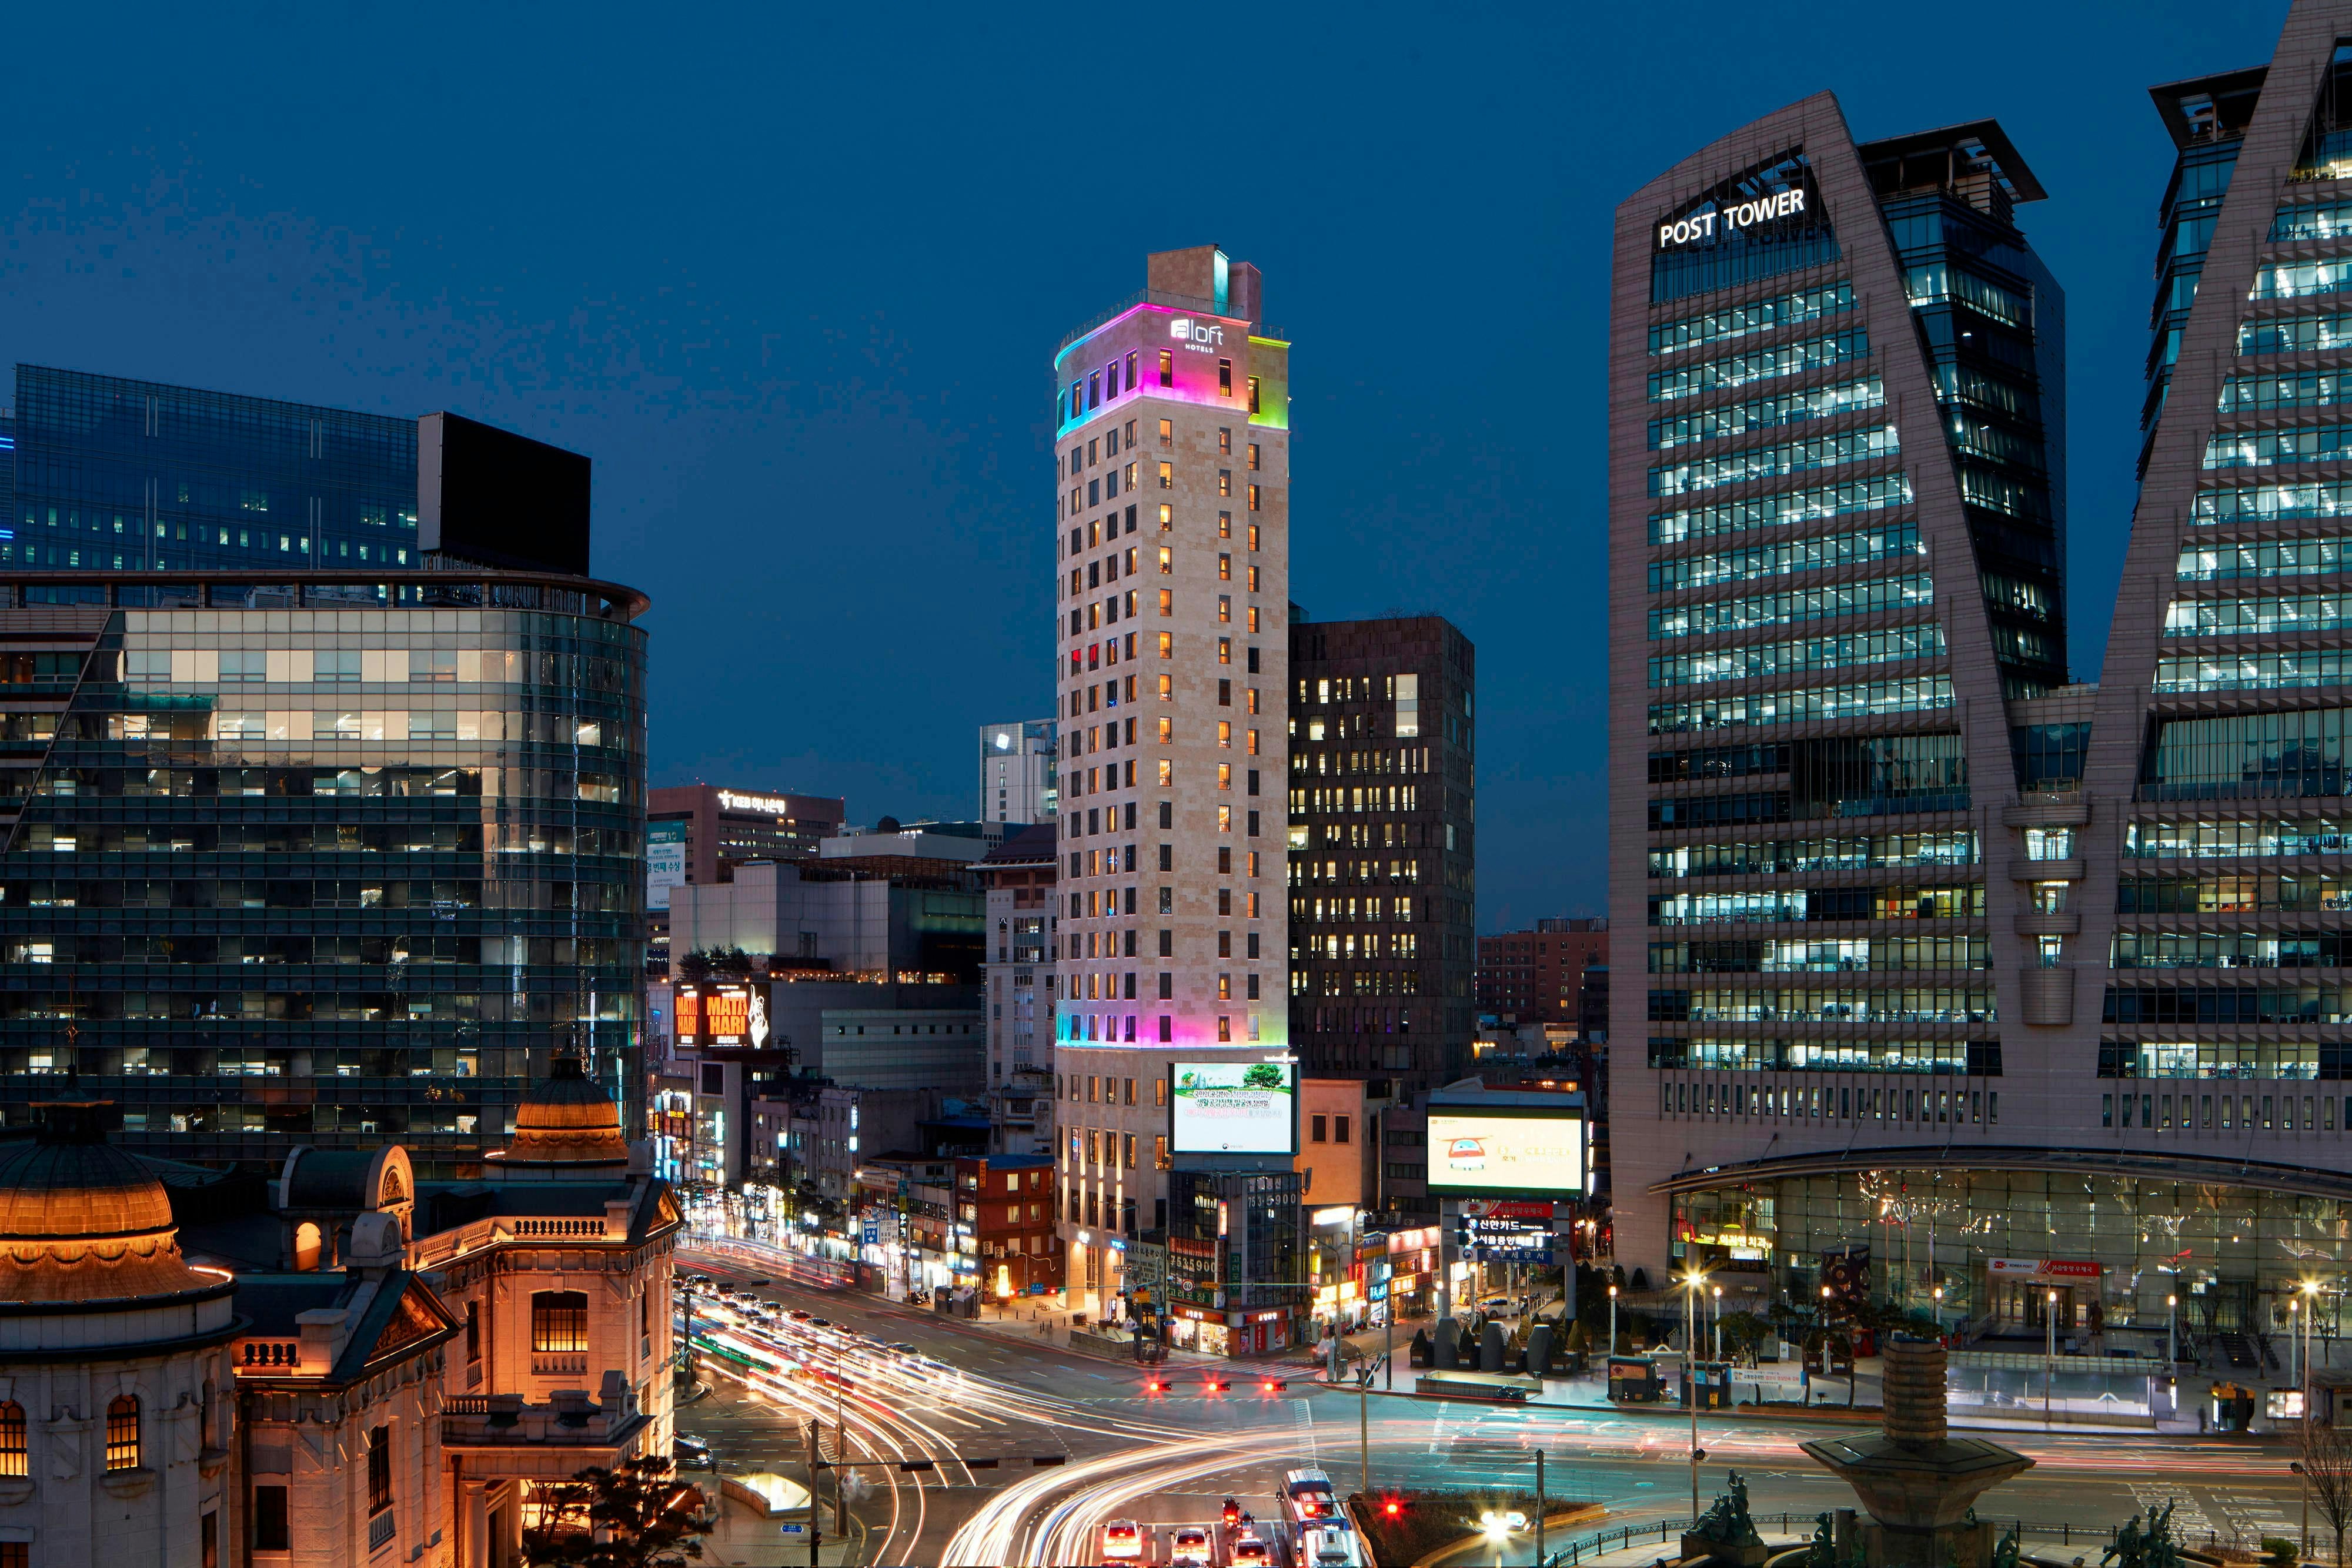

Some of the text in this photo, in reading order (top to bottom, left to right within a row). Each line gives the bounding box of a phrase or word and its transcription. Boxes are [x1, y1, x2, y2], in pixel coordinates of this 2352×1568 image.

[1661, 189, 1805, 248] POST TOWER
[1171, 319, 1223, 345] aloft
[1185, 343, 1214, 353] HOTELS
[733, 795, 786, 814] KEB 하나은행
[653, 862, 666, 872] 번째
[668, 861, 680, 872] 수상
[676, 997, 697, 1015] MATA
[707, 997, 748, 1015] MATA
[677, 1015, 696, 1034] HARI
[710, 1015, 746, 1034] HARI
[1248, 1193, 1297, 1208] 753-5900
[1479, 1219, 1520, 1231] 신한카드
[1748, 1236, 1766, 1248] 치과
[1486, 1251, 1544, 1261] 중부세무서
